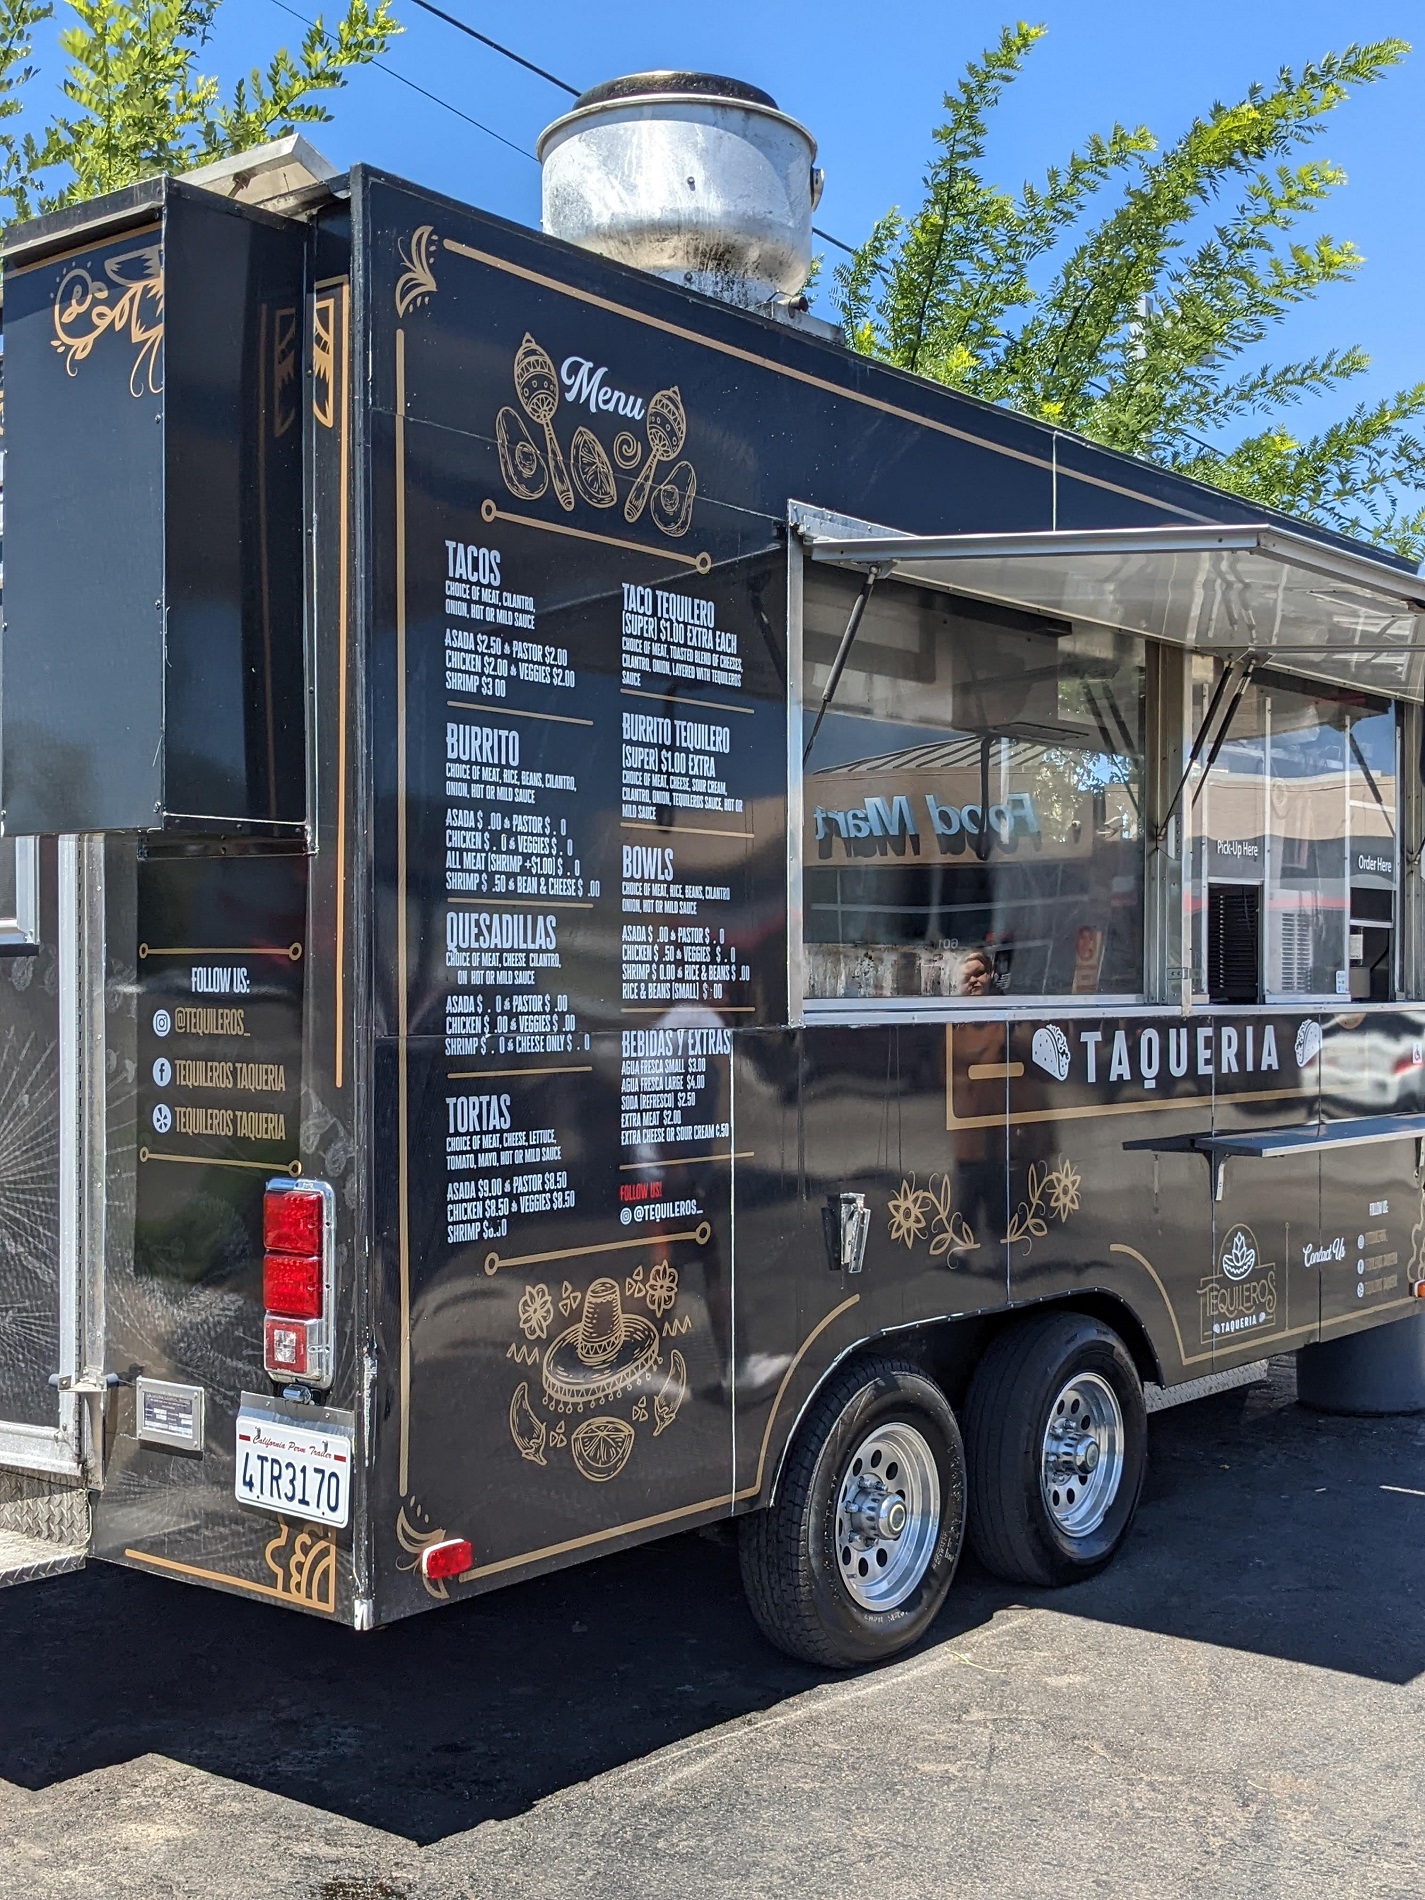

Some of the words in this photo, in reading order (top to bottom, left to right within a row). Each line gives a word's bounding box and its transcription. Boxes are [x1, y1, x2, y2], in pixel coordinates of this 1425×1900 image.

[561, 356, 645, 420] Menu
[445, 540, 500, 586] TACOS
[446, 580, 470, 599] CHOICE
[472, 585, 479, 601] OF
[482, 587, 501, 605] MEAT,
[503, 591, 535, 611] CILANTRO,
[622, 583, 652, 615] TACO
[656, 590, 714, 628] TEQUILERO
[446, 599, 469, 618] ONION,
[471, 604, 483, 620] HOT
[486, 606, 495, 622] OR
[497, 608, 512, 625] MILD
[514, 612, 535, 629] SAUCE
[623, 611, 657, 640] (SUPER)
[660, 619, 684, 644] $1.00
[687, 625, 713, 649] EXTRA
[716, 631, 737, 654] EACH
[445, 628, 475, 651] ASADA
[477, 634, 501, 656] $2.50
[513, 640, 542, 662] PASTOR
[545, 646, 567, 666] $2.00
[446, 650, 481, 673] CHICKEN
[484, 656, 508, 677] $2.00
[519, 662, 550, 683] VEGGIES
[553, 667, 575, 687] $2.00
[446, 671, 479, 693] SHRIMP
[446, 722, 519, 766] BURRITO
[622, 712, 671, 745] BURRITO
[674, 720, 730, 753] TEQUILERO
[623, 744, 658, 772] (SUPER)
[661, 749, 686, 773] $1.00
[689, 754, 715, 777] EXTRA
[446, 809, 475, 829] ASADA
[512, 814, 543, 834] PASTOR
[446, 830, 482, 850] CHICKEN
[518, 835, 549, 854] VEGGIES
[1217, 840, 1242, 858] Pick-Up
[1243, 842, 1258, 856] Here
[446, 851, 461, 869] ALL
[463, 852, 486, 870] MEAT
[488, 854, 522, 873] (SHRIMP
[622, 845, 673, 881] BOWLS
[1358, 855, 1376, 870] Order
[1377, 857, 1392, 872] Here
[446, 872, 479, 891] SHRIMP
[517, 876, 538, 894] BEAN
[540, 877, 546, 894] &
[549, 878, 576, 896] CHEESE
[446, 912, 556, 952] QUESADILLAS
[622, 925, 646, 942] ASADA
[678, 927, 703, 943] PASTOR
[622, 945, 652, 961] CHICKEN
[683, 946, 710, 962] VEGGIES
[192, 967, 232, 992] FOLLOW
[233, 967, 250, 993] US:
[622, 964, 650, 980] SHRIMP
[684, 965, 699, 980] RICE
[701, 965, 707, 980] &
[709, 965, 729, 980] BEANS
[446, 996, 475, 1013] ASADA
[513, 995, 542, 1012] PASTOR
[622, 983, 638, 999] RICE
[640, 983, 646, 999] &
[648, 983, 670, 999] BEANS
[672, 983, 699, 999] (SMALL)
[446, 1016, 481, 1034] CHICKEN
[519, 1015, 550, 1032] VEGGIES
[445, 1037, 478, 1056] SHRIMP
[516, 1035, 544, 1053] CHEESE
[546, 1035, 565, 1052] ONLY
[622, 1030, 673, 1057] BEBIDAS
[677, 1029, 684, 1055] Y
[688, 1029, 731, 1055] EXTRAS
[621, 1060, 639, 1075] AGUA
[641, 1060, 663, 1074] FRESCA
[665, 1059, 685, 1074] SMALL
[1080, 1024, 1279, 1089] TAQUERIA
[174, 1060, 234, 1088] TEQUILEROS
[235, 1063, 286, 1092] TAQUERIA
[621, 1078, 639, 1092] AGUA
[640, 1077, 663, 1092] FRESCA
[665, 1076, 683, 1090] LARGE
[446, 1094, 511, 1133] TORTAS
[621, 1095, 638, 1110] SODA
[677, 1092, 695, 1107] $2.50
[174, 1107, 234, 1136] TEQUILEROS
[235, 1111, 286, 1140] TAQUERIA
[621, 1113, 640, 1128] EXTRA
[643, 1111, 660, 1126] MEAT
[621, 1129, 640, 1145] EXTRA
[642, 1128, 665, 1143] CHEESE
[666, 1127, 675, 1142] OR
[676, 1126, 692, 1141] SOUR
[694, 1124, 714, 1139] CREAM
[447, 1180, 476, 1201] ASADA
[478, 1178, 502, 1198] $9.00
[513, 1174, 542, 1194] PASTOR
[545, 1172, 567, 1190] $8.50
[620, 1183, 648, 1201] FOLLOW
[447, 1201, 482, 1222] CHICKEN
[485, 1198, 509, 1218] $8.50
[520, 1193, 550, 1214] VEGGIES
[553, 1190, 575, 1210] $8.50
[448, 1222, 480, 1243] SHRIMP
[1303, 1244, 1332, 1267] Contact
[1332, 1237, 1346, 1260] Us
[1197, 1270, 1276, 1318] TEQUILEROS
[1221, 1315, 1257, 1334] TAQUERIA
[253, 1435, 286, 1450] California
[287, 1442, 306, 1454] Perm
[309, 1446, 332, 1459] Trailer
[242, 1452, 340, 1512] 4TR3170
